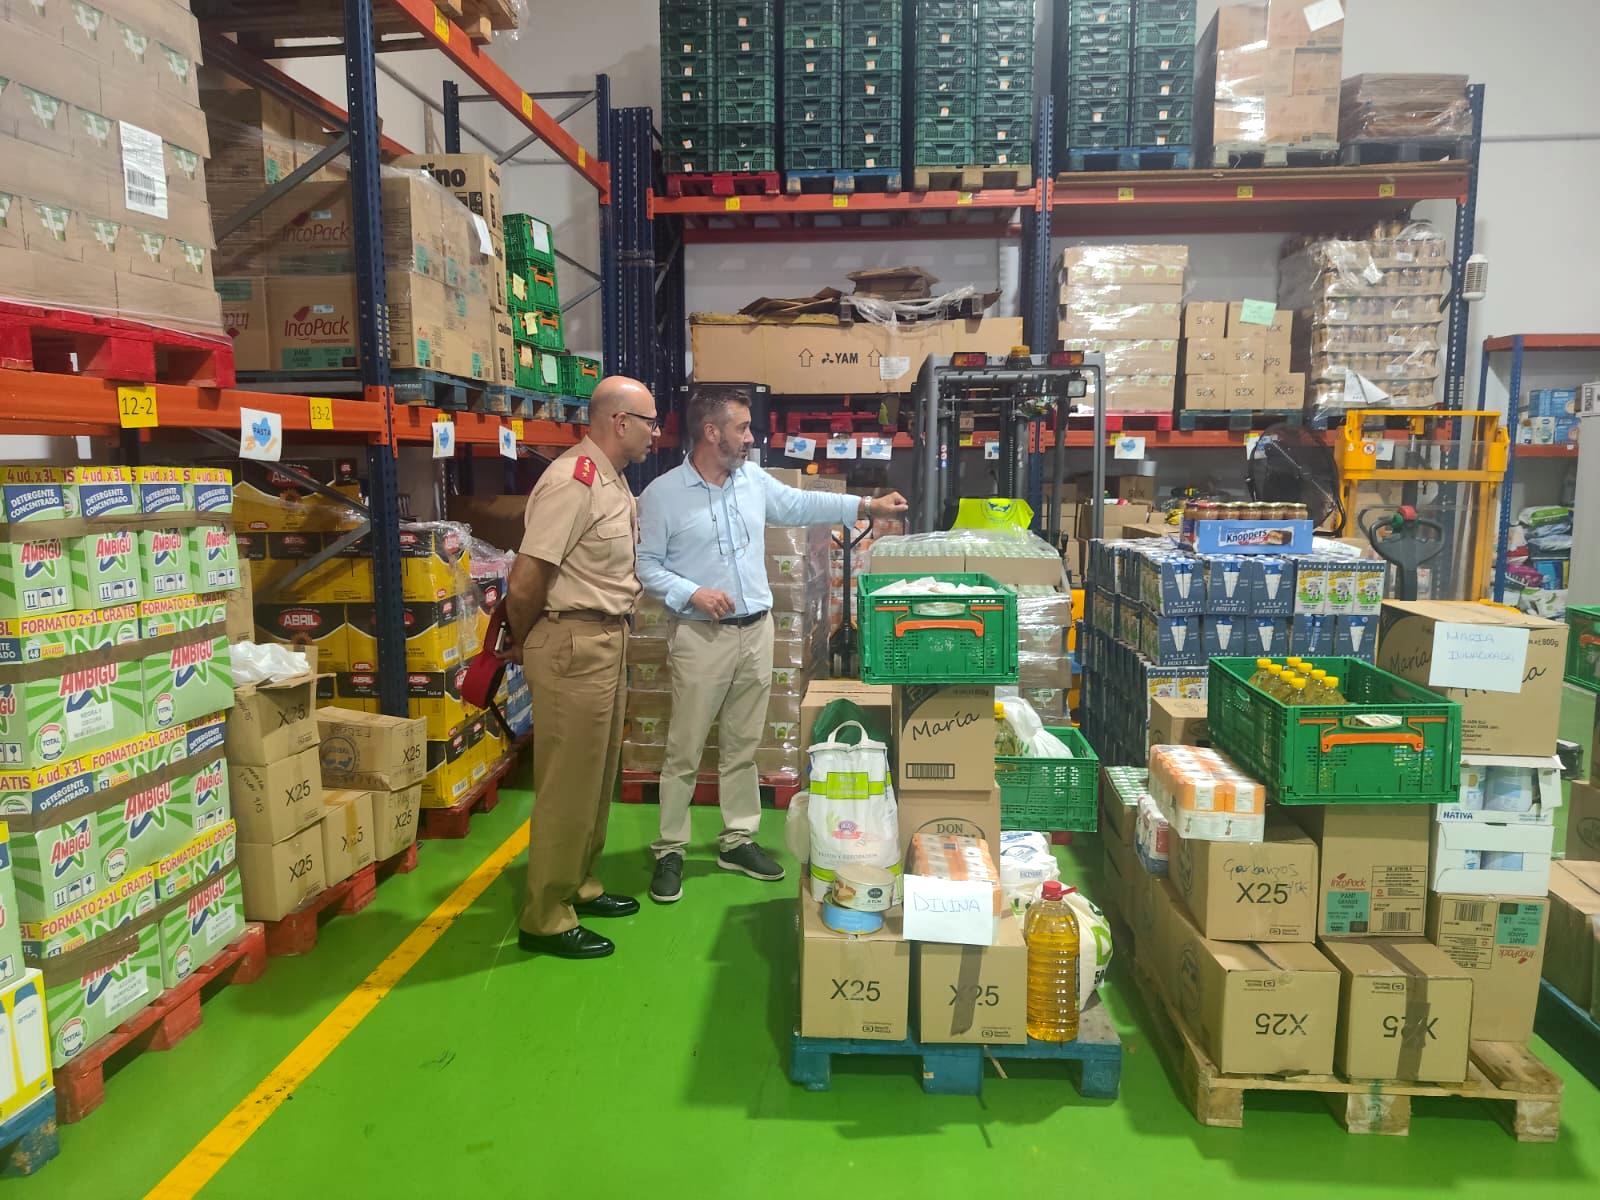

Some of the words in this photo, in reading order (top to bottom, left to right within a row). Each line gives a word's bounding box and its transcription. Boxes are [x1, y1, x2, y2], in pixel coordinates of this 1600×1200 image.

[284, 315, 349, 337] IncoPack
[835, 353, 858, 364] YAM
[1275, 386, 1294, 395] X25
[121, 396, 154, 415] 12-2
[311, 406, 331, 421] 13-2
[253, 427, 272, 436] PASTA
[44, 469, 56, 482] 3L
[114, 469, 125, 481] 3L
[10, 489, 55, 508] DETERGENTE
[85, 488, 124, 506] DETERGENTE
[86, 495, 129, 516] CONCENTRADO
[145, 488, 177, 504] DETERGENTE
[145, 494, 180, 512] CONCENTRADO
[10, 496, 59, 518] CONCENTRADO
[1226, 530, 1267, 543] Knoppers
[143, 597, 184, 615] FORMATO
[21, 614, 76, 635] FORMATO
[79, 610, 101, 626] 2+1L
[103, 604, 136, 621] GRATIS
[284, 614, 318, 626] ABRIL
[353, 676, 374, 684] ABRIL
[912, 711, 980, 741] María
[42, 738, 60, 746] TOTAL
[92, 743, 138, 769] FORMATO
[139, 736, 158, 752] 2+1L
[159, 725, 186, 743] GRATIS
[403, 744, 421, 764] X25
[37, 774, 44, 785] 4
[72, 760, 86, 772] 3L
[40, 779, 84, 811] DETERGENTE
[286, 780, 312, 806] X25
[394, 809, 412, 829] X25
[1443, 811, 1473, 820] NATIVA
[936, 823, 963, 834] DON
[159, 846, 197, 875] FORMATO
[214, 823, 236, 843] GRATIS
[109, 861, 124, 870] TOTAL
[288, 854, 314, 882] X25
[913, 891, 981, 912] DIVINA
[1236, 882, 1289, 905] X25
[41, 903, 96, 939] FORMATO
[98, 891, 120, 909] 2+1L
[121, 871, 153, 898] GRATIS
[830, 979, 881, 1002] X25
[1255, 1013, 1308, 1036] X25
[63, 1032, 81, 1044] TOTAL
